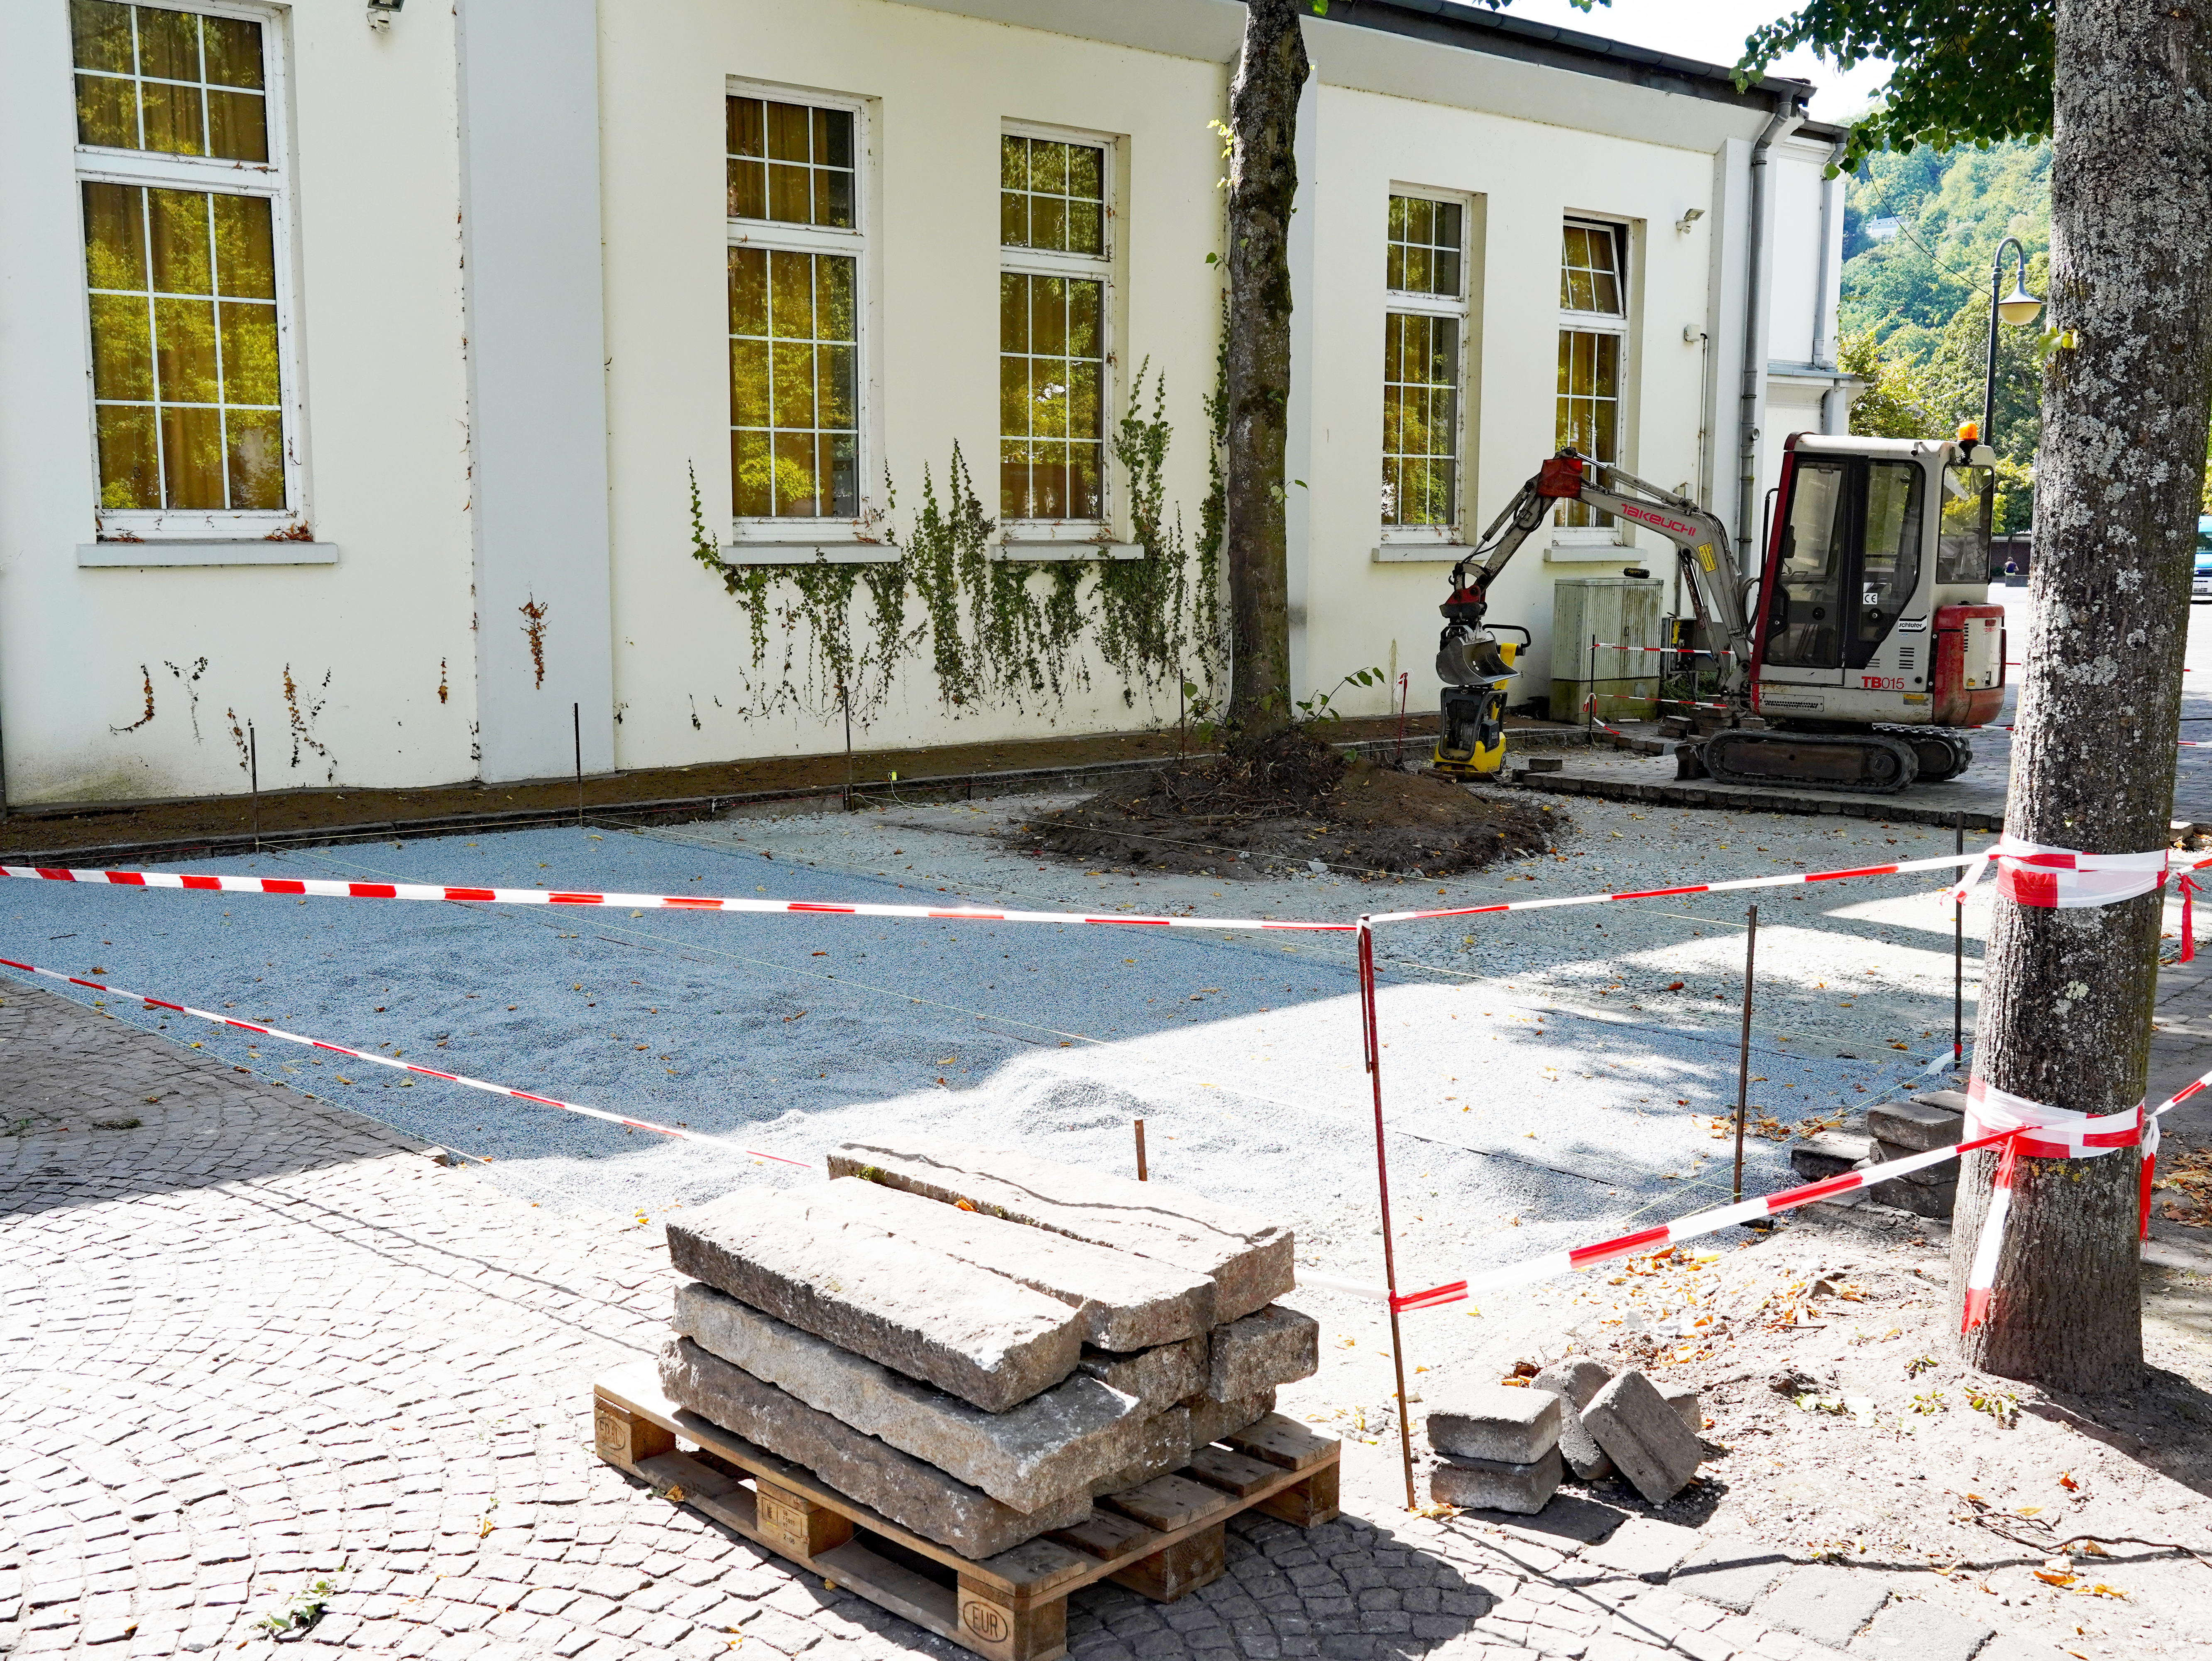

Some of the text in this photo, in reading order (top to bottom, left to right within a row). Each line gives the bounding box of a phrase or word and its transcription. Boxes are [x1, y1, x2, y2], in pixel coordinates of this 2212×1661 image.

[1621, 503, 1696, 537] TAKEUCHI
[1865, 594, 1876, 603] CE
[1861, 676, 1904, 689] TB015
[972, 1606, 998, 1638] EUR
